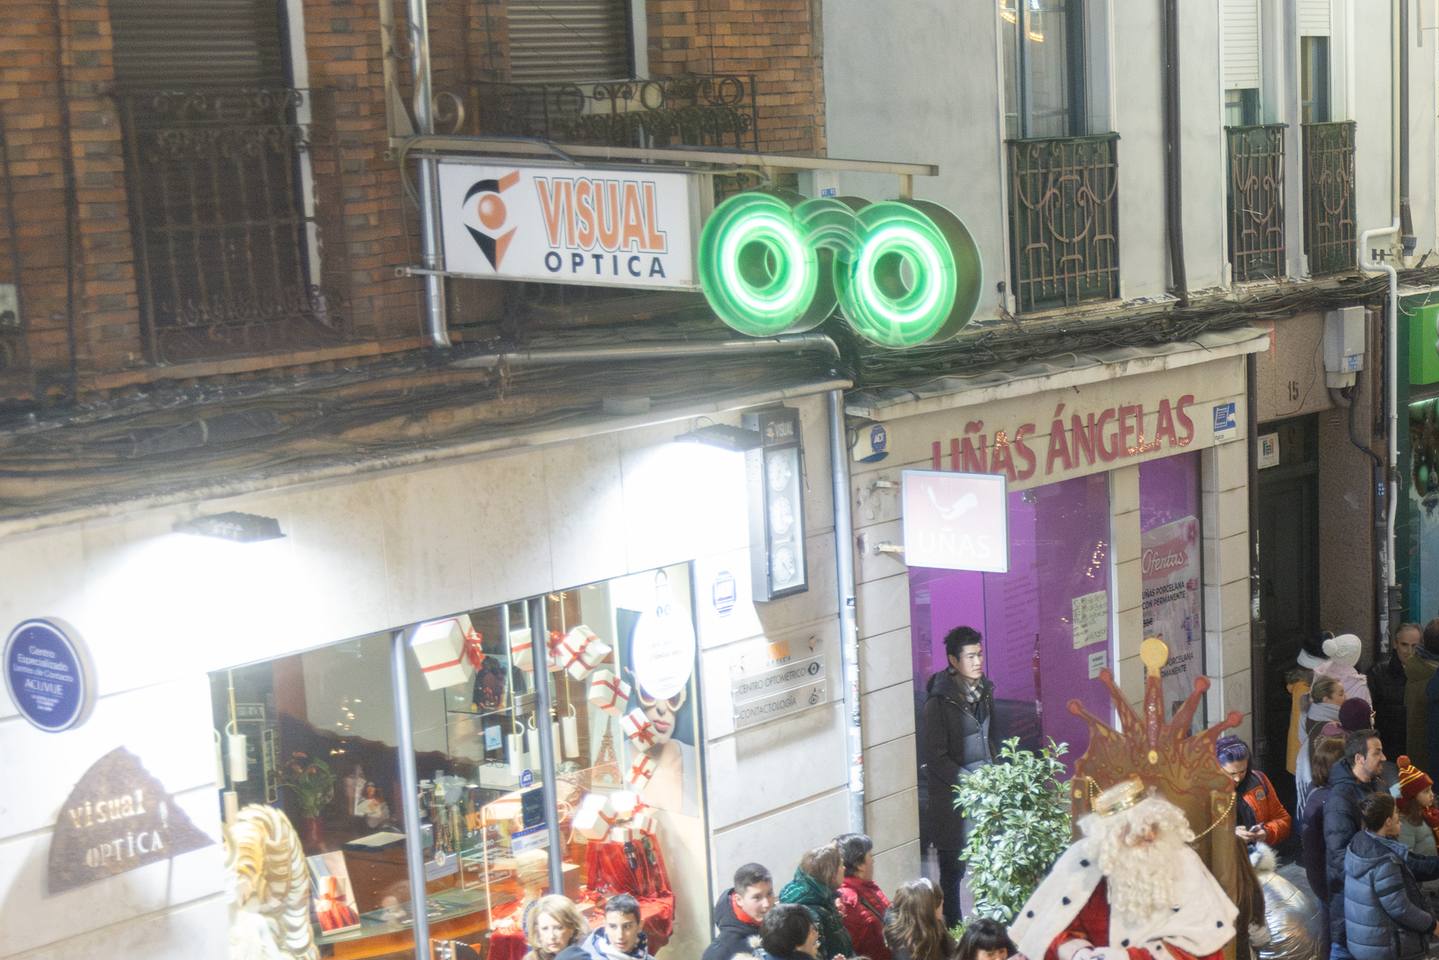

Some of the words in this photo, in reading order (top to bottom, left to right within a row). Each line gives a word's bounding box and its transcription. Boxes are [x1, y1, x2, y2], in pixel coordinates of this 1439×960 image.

[534, 177, 668, 254] VISUAL
[544, 251, 666, 278] OPTICA
[1288, 381, 1300, 401] 15
[1045, 394, 1194, 476] ÁNGELAS
[919, 528, 992, 559] UÑAS
[1143, 549, 1185, 577] Ofertas
